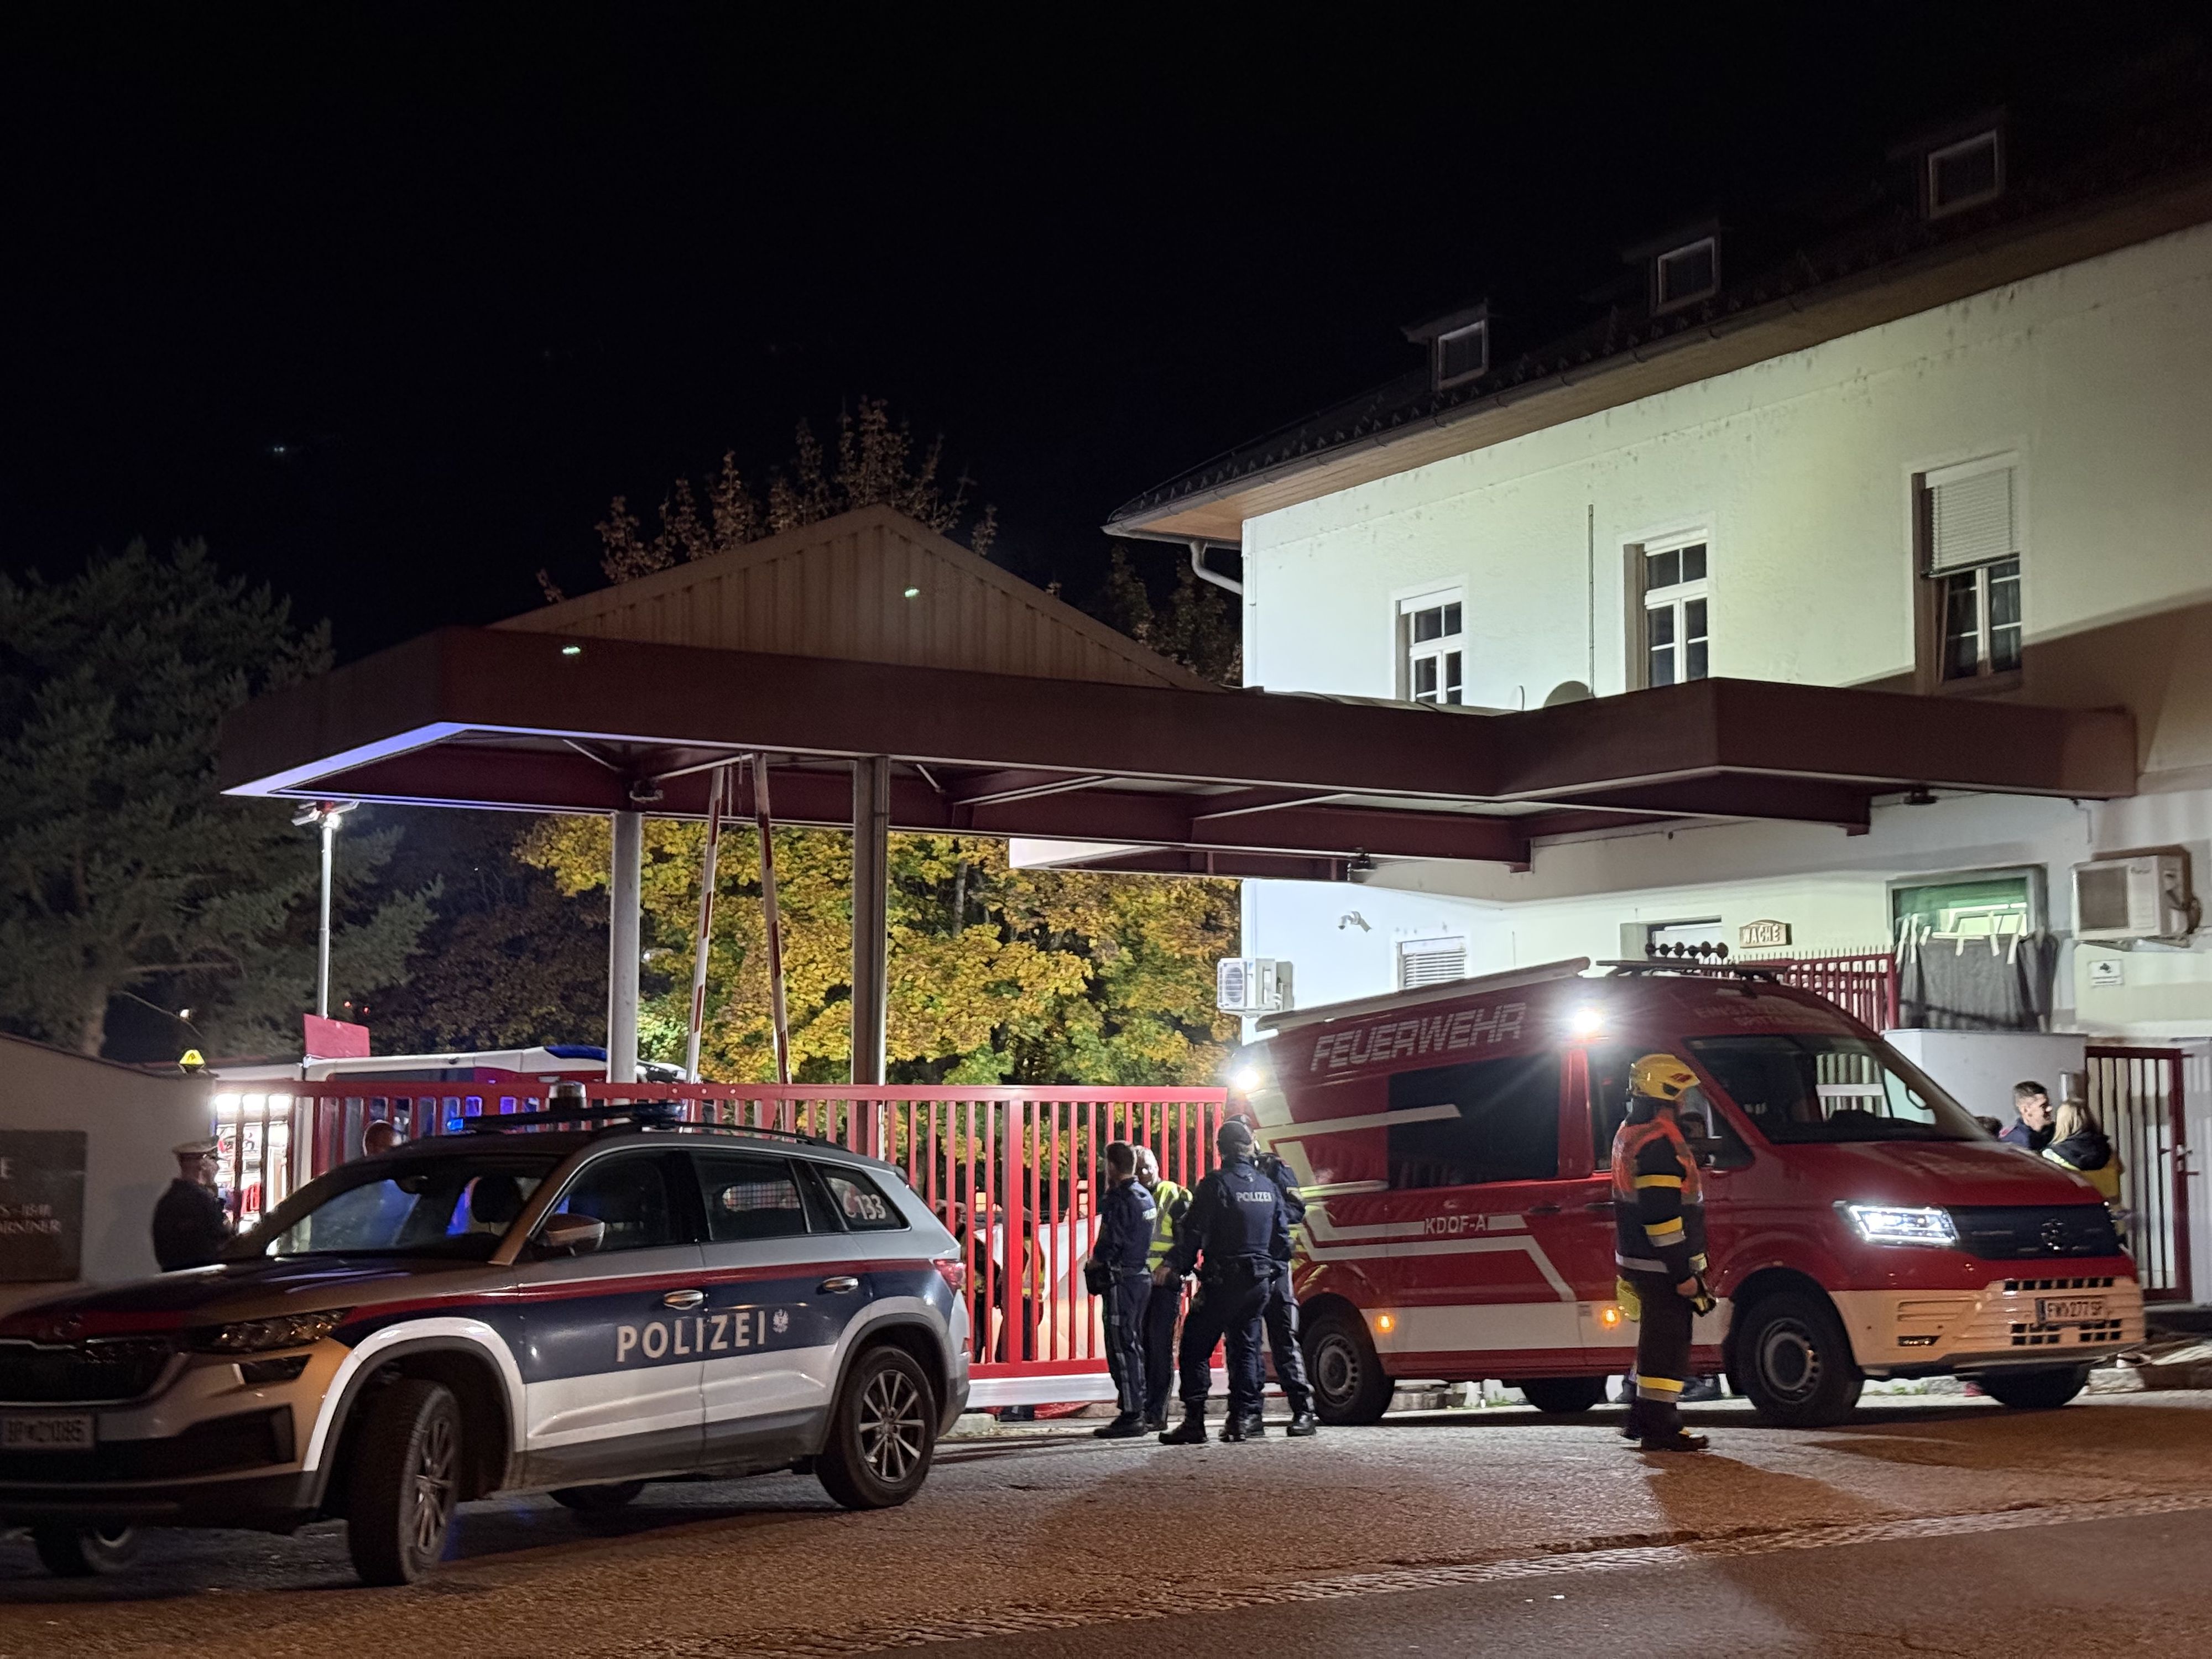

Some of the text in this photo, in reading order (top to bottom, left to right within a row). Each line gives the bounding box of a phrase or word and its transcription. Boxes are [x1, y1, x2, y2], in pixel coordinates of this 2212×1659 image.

[1743, 924, 1780, 944] WACHE
[1310, 1001, 1527, 1072] FEUERWEHR
[853, 1193, 886, 1220] 133
[1235, 1191, 1272, 1203] POLIZEI
[1425, 1214, 1486, 1235] KDOF-A
[616, 1310, 765, 1363] POLIZEI
